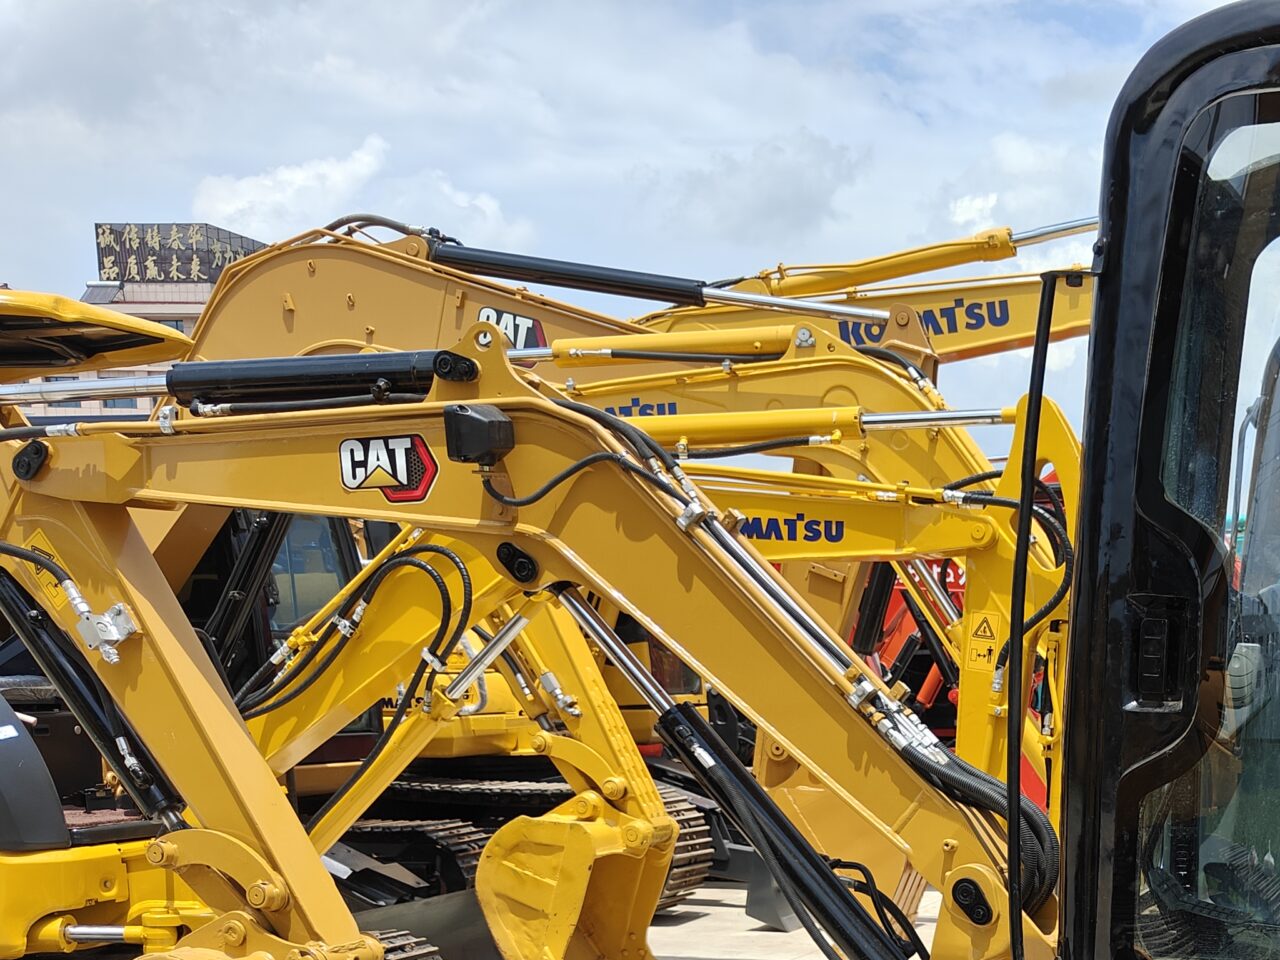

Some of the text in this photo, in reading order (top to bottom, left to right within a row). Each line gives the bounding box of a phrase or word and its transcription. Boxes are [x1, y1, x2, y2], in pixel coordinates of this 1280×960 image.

[101, 254, 208, 281] 品质赢未来
[838, 298, 1010, 346] KOATSU
[340, 437, 411, 489] CAT
[740, 513, 844, 543] MATSU
